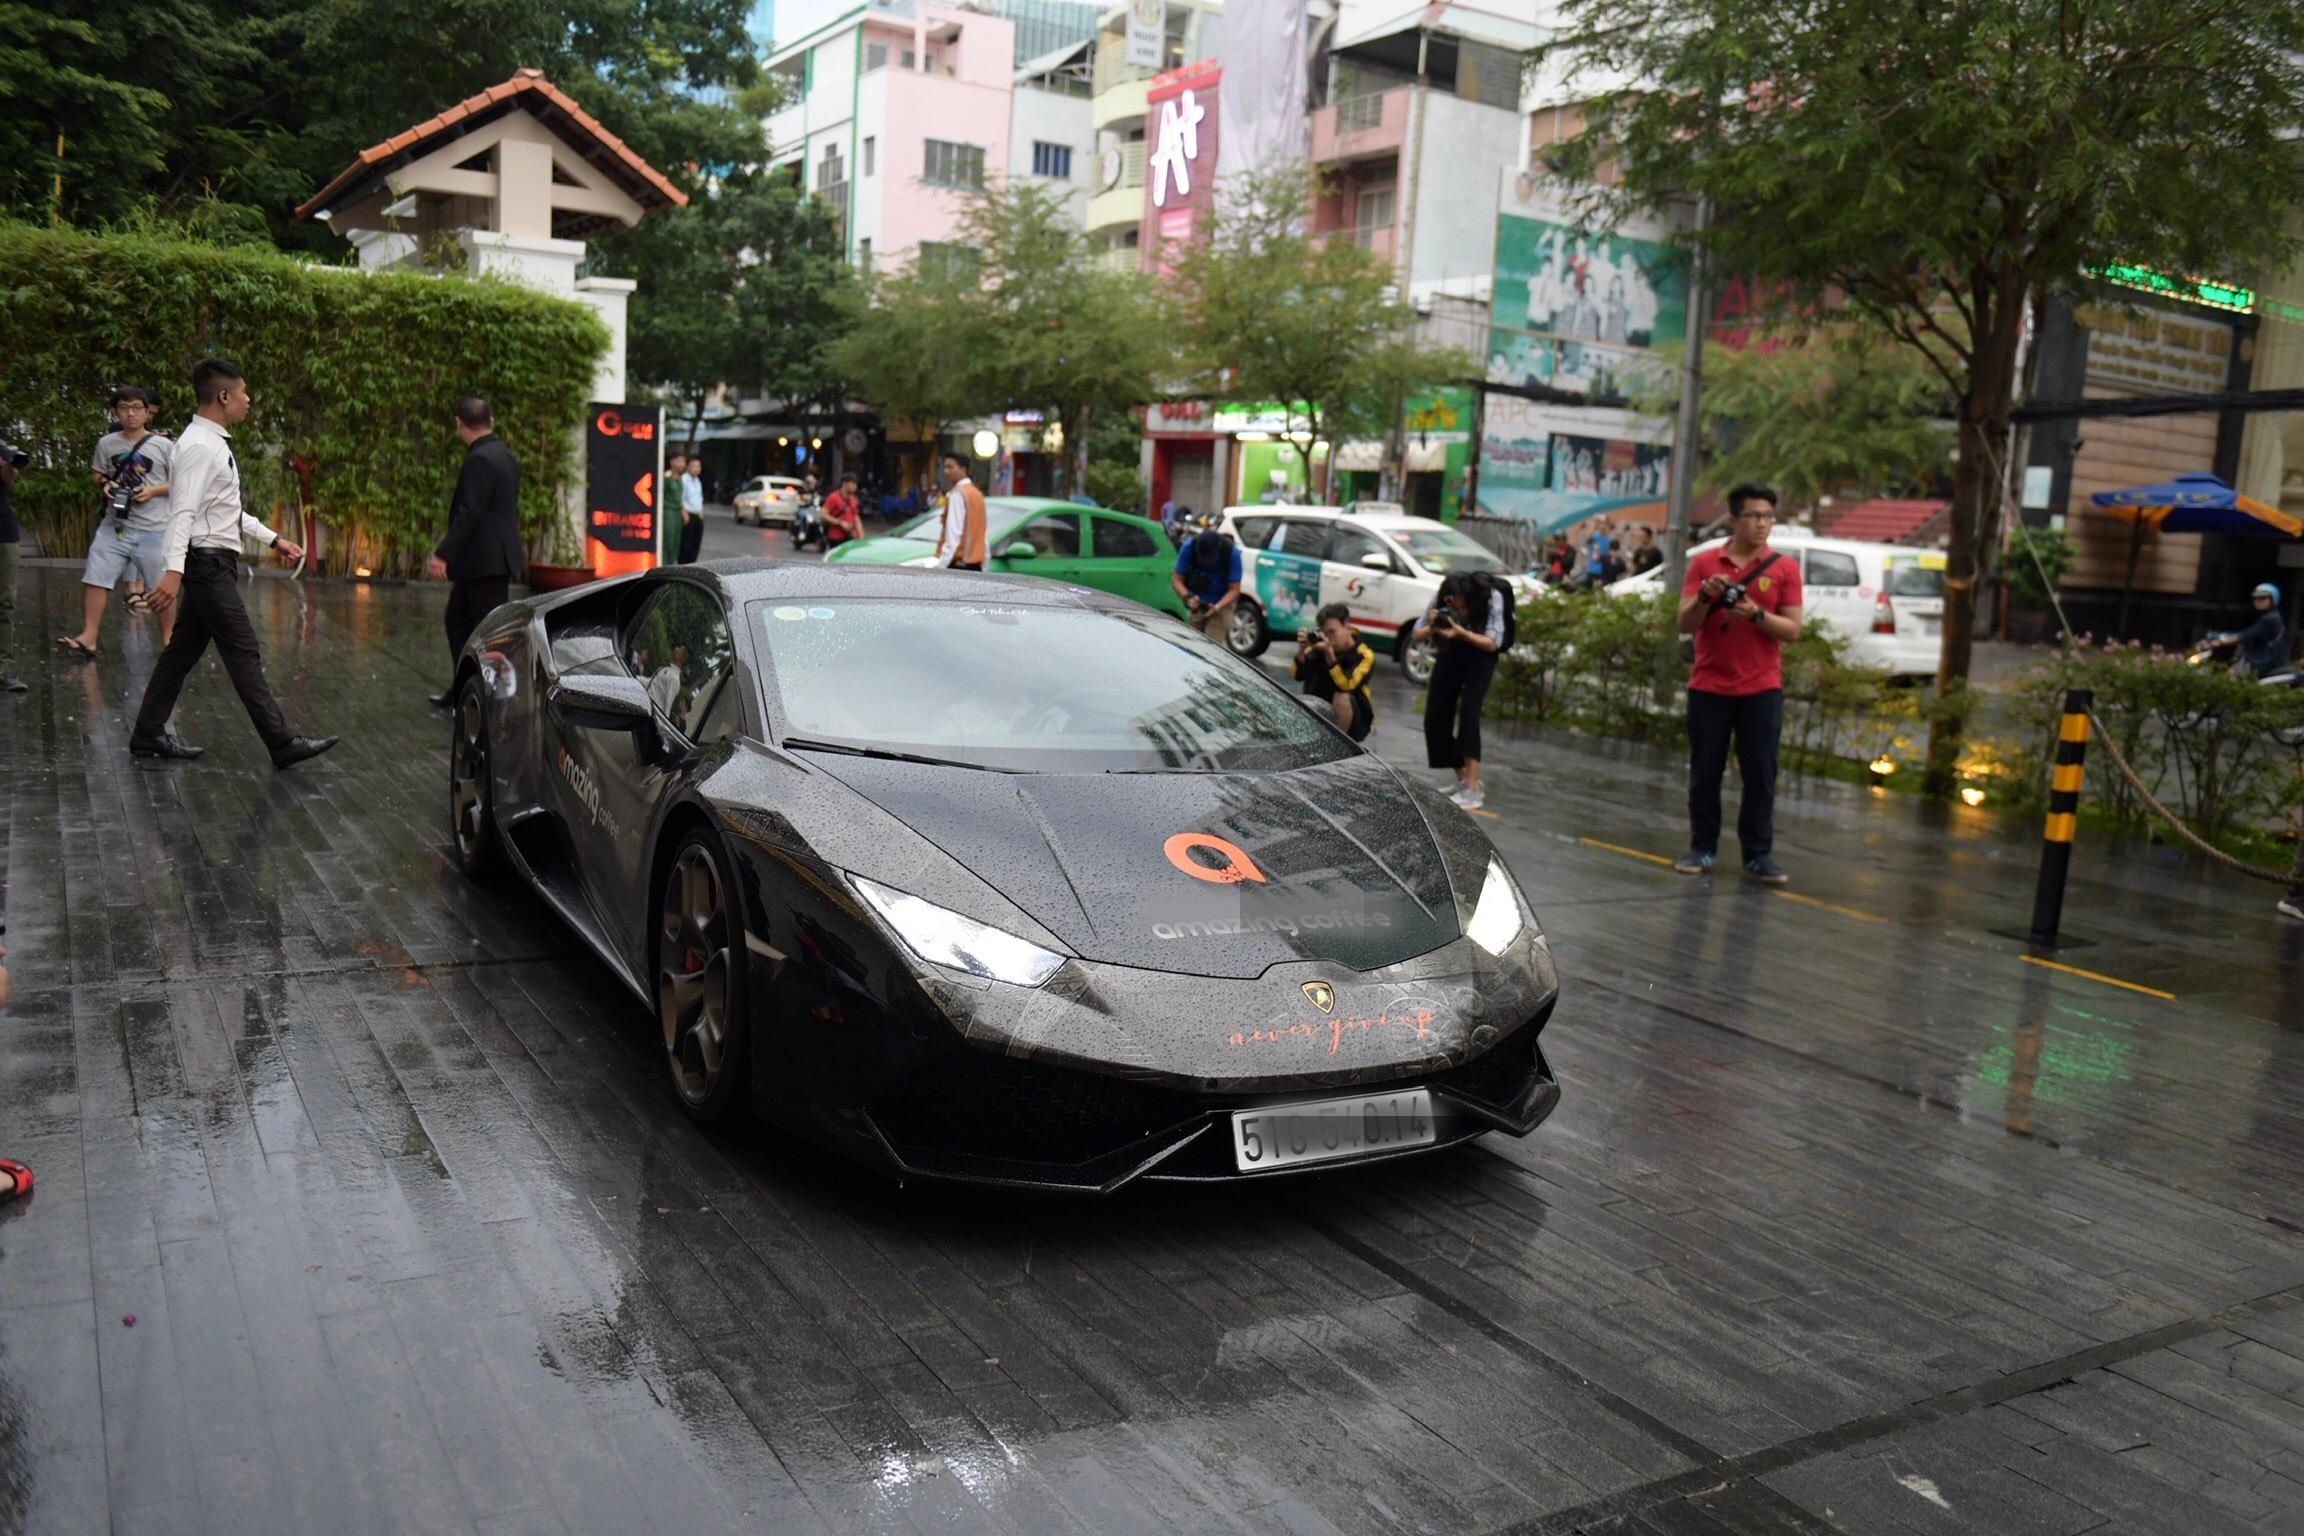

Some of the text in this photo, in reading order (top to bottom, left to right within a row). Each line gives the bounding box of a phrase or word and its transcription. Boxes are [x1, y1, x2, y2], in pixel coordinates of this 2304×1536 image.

[592, 511, 652, 529] ENTRANCE
[559, 746, 620, 840] amazing coffee
[1152, 910, 1392, 939] amazing coffee
[1229, 1008, 1438, 1057] never give up
